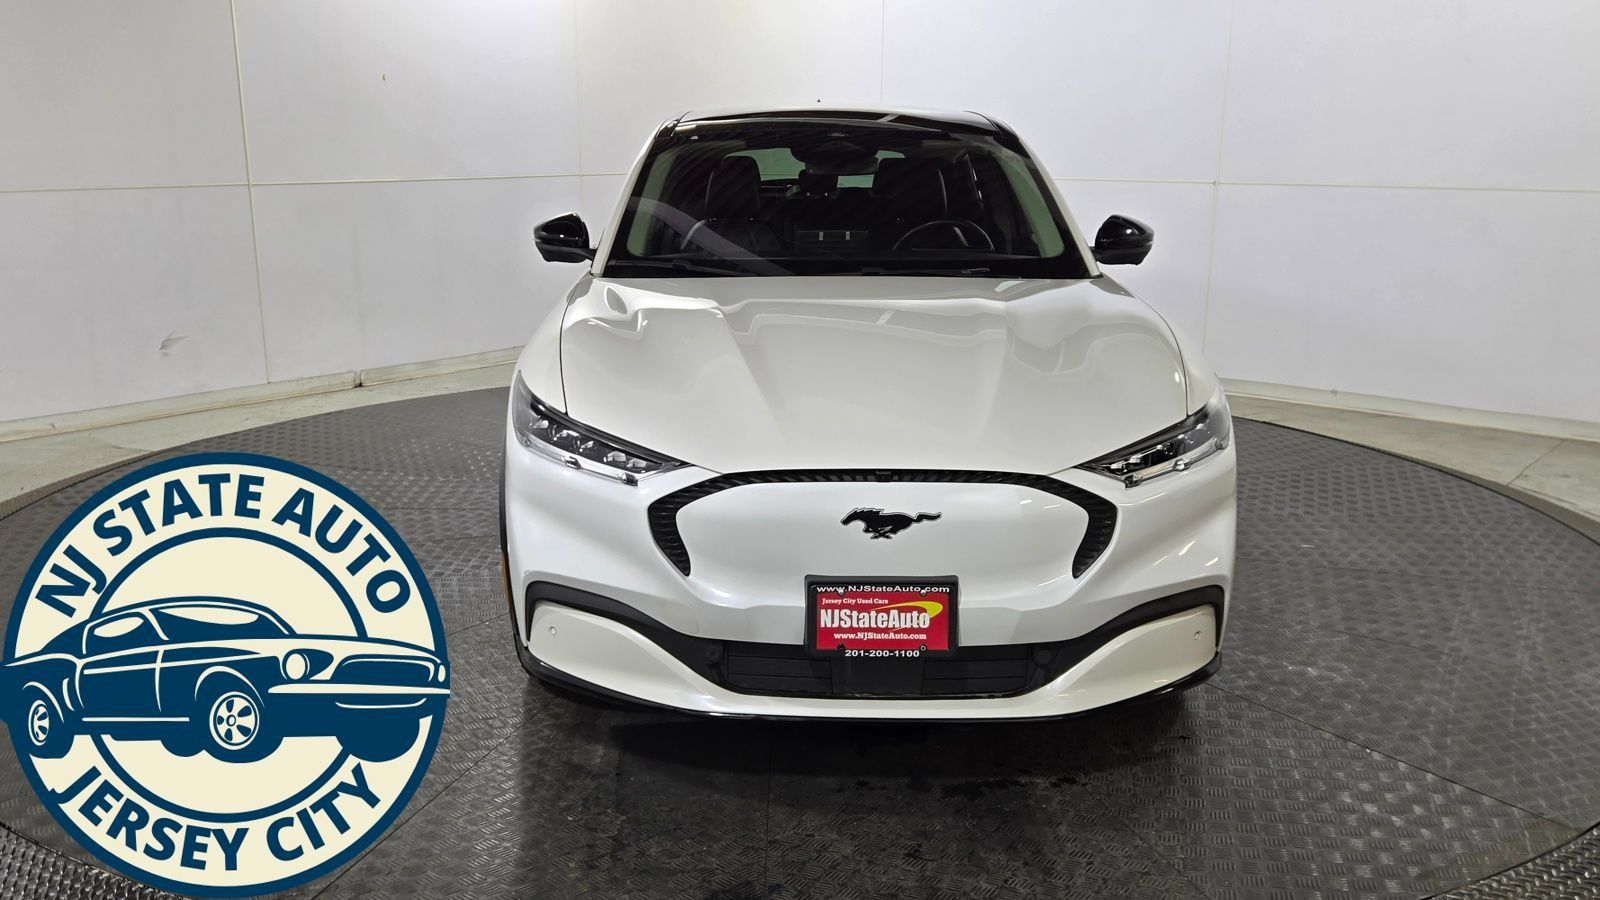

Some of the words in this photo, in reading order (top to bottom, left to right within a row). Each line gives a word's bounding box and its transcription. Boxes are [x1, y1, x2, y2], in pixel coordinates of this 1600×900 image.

[816, 585, 950, 593] www.NJStateAuto.com
[820, 609, 931, 629] NJStateAuto
[834, 632, 927, 640] www.NJStateAuto.com
